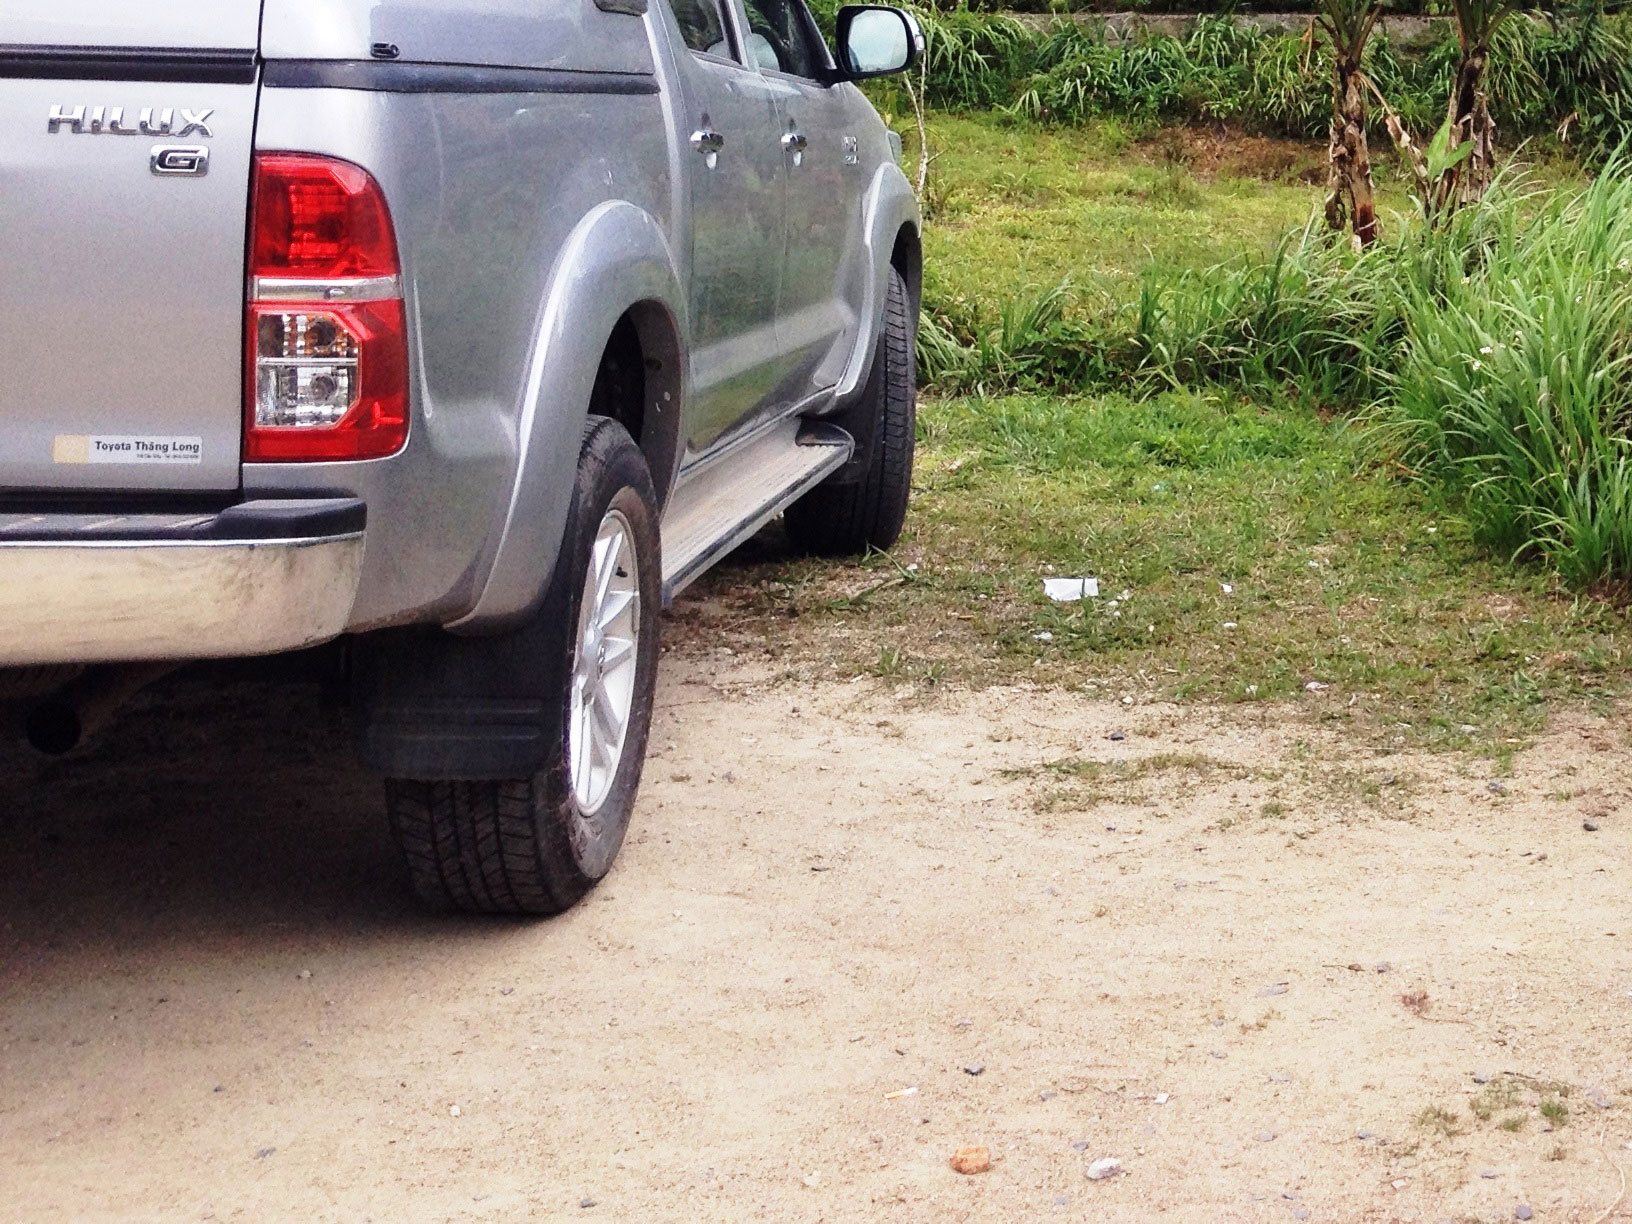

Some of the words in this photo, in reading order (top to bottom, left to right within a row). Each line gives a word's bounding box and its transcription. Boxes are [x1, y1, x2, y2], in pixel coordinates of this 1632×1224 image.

[47, 104, 215, 138] HILUX
[154, 146, 204, 175] G
[94, 440, 132, 452] Toyota
[172, 441, 201, 454] Long
